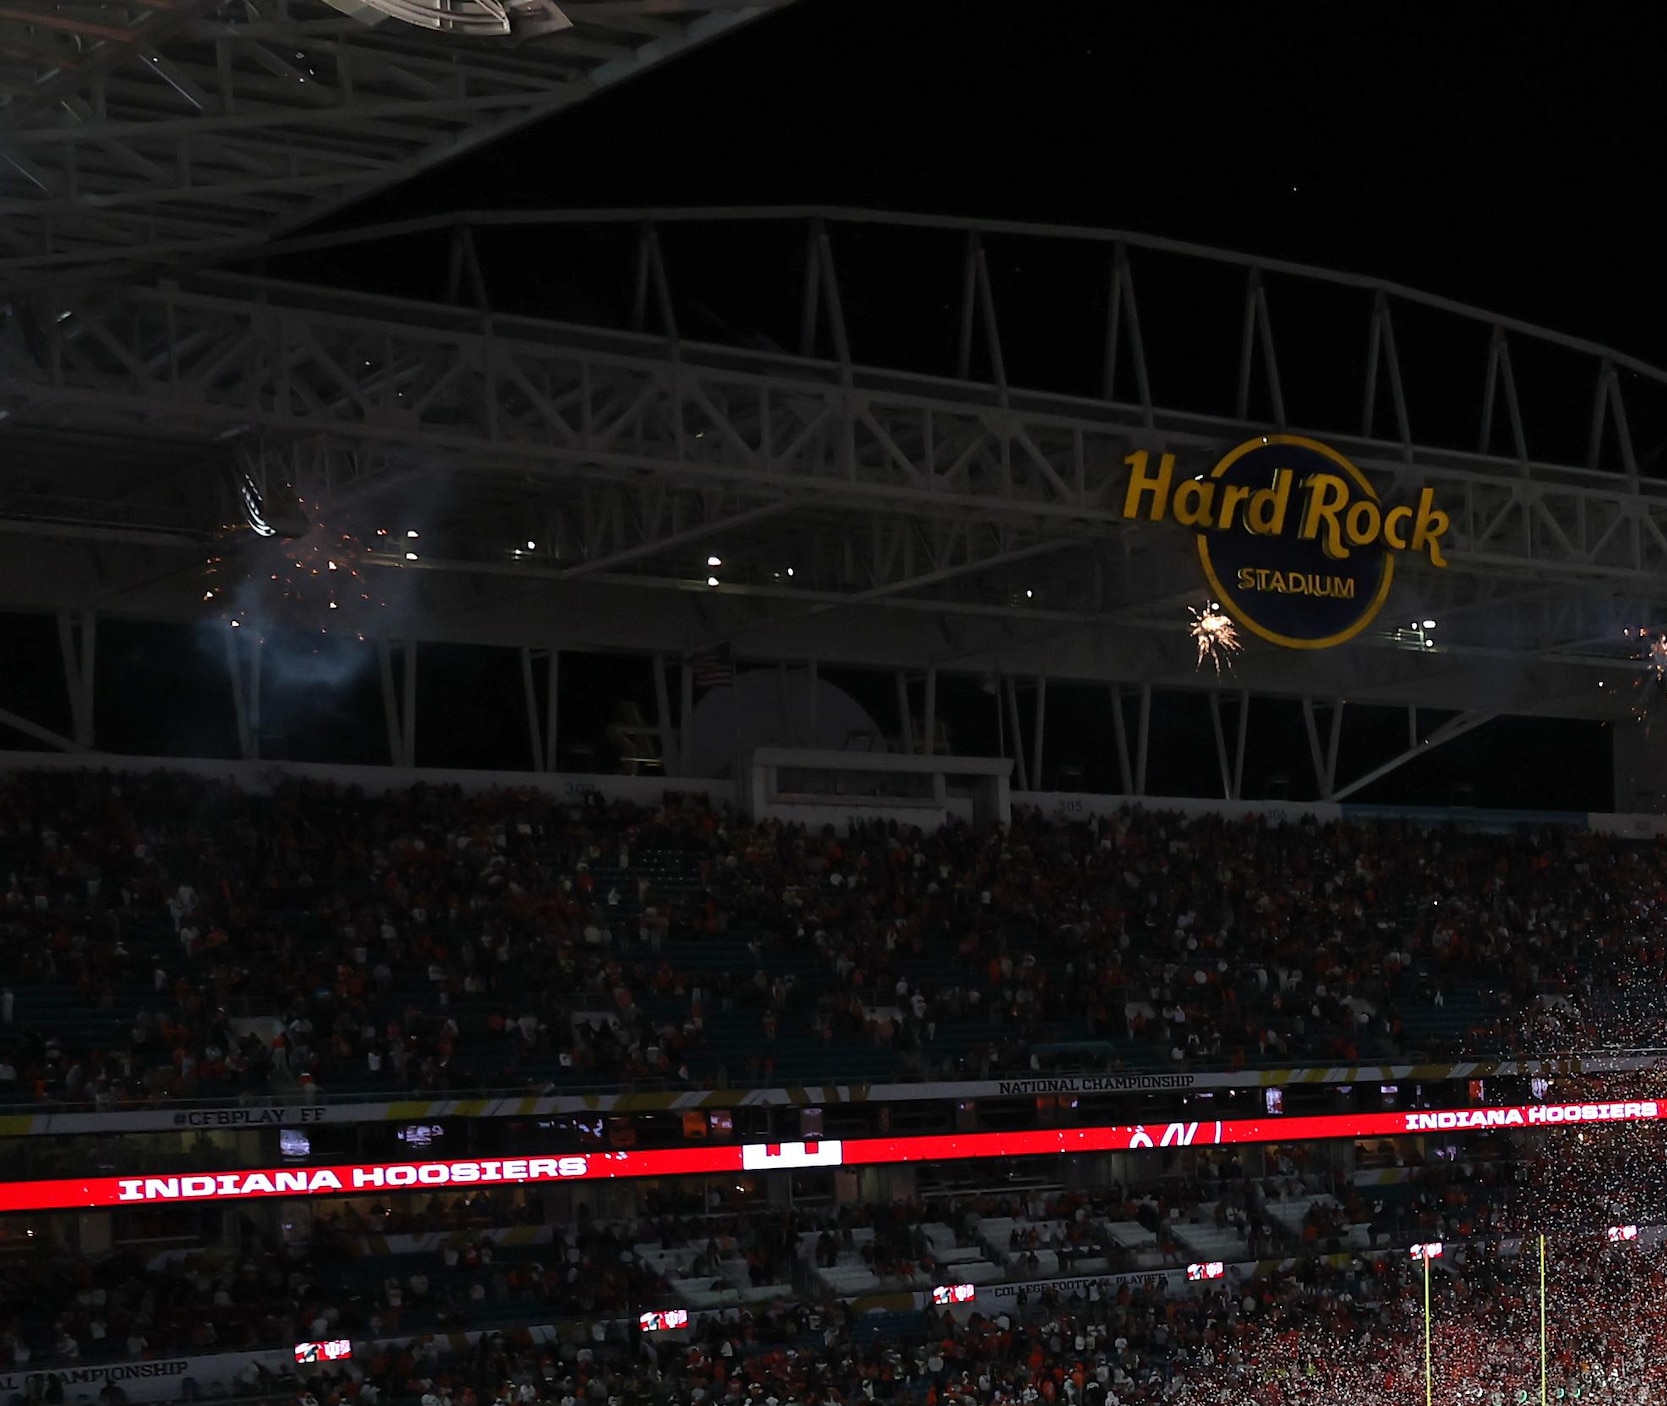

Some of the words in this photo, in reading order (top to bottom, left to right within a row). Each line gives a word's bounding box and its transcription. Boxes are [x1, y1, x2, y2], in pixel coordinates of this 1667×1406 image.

[1123, 449, 1292, 536] Hard
[1300, 472, 1450, 568] Rock
[1238, 568, 1354, 598] STADIUM
[1000, 1080, 1079, 1094] NATIONAL
[1082, 1075, 1194, 1091] CHAMPIONSHIP
[1405, 1107, 1523, 1131] INDIANA
[1528, 1101, 1658, 1126] HOOSIERS
[118, 1168, 343, 1201] INDIANA
[352, 1156, 587, 1188] HOOSIERS
